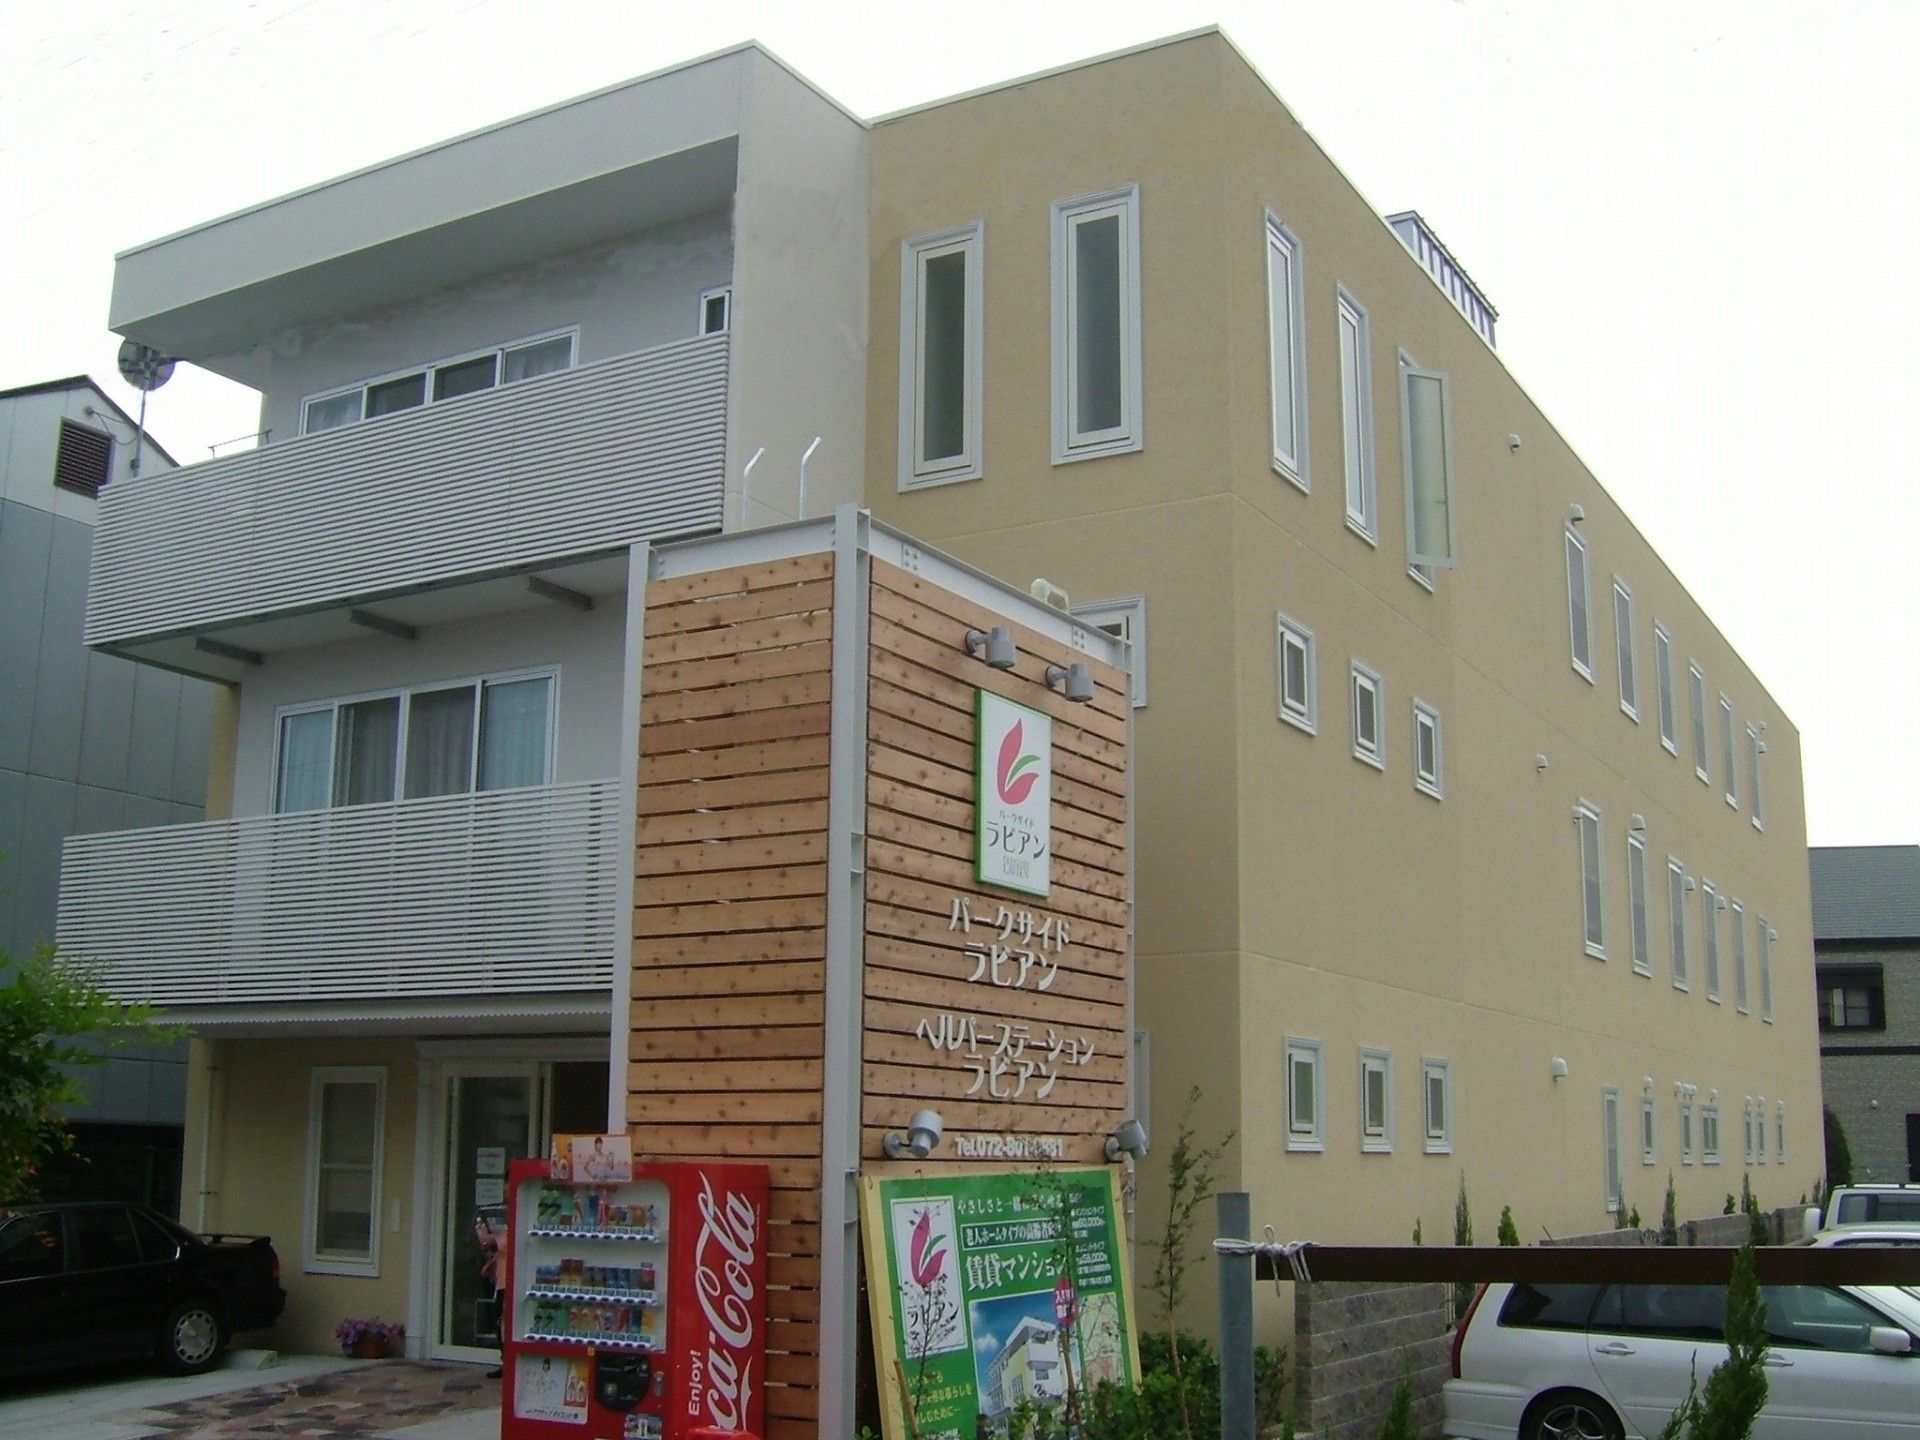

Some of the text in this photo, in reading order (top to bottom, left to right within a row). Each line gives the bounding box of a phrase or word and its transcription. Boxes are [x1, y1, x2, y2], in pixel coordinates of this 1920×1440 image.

[949, 897, 1070, 952] パークサイド
[964, 940, 1058, 990] ラビアン
[915, 1014, 1095, 1066] ヘルパーステーション
[963, 1054, 1057, 1099] ラビアン
[965, 1251, 1067, 1291] 賃貸マンション
[688, 1349, 703, 1416] Enjoy!
